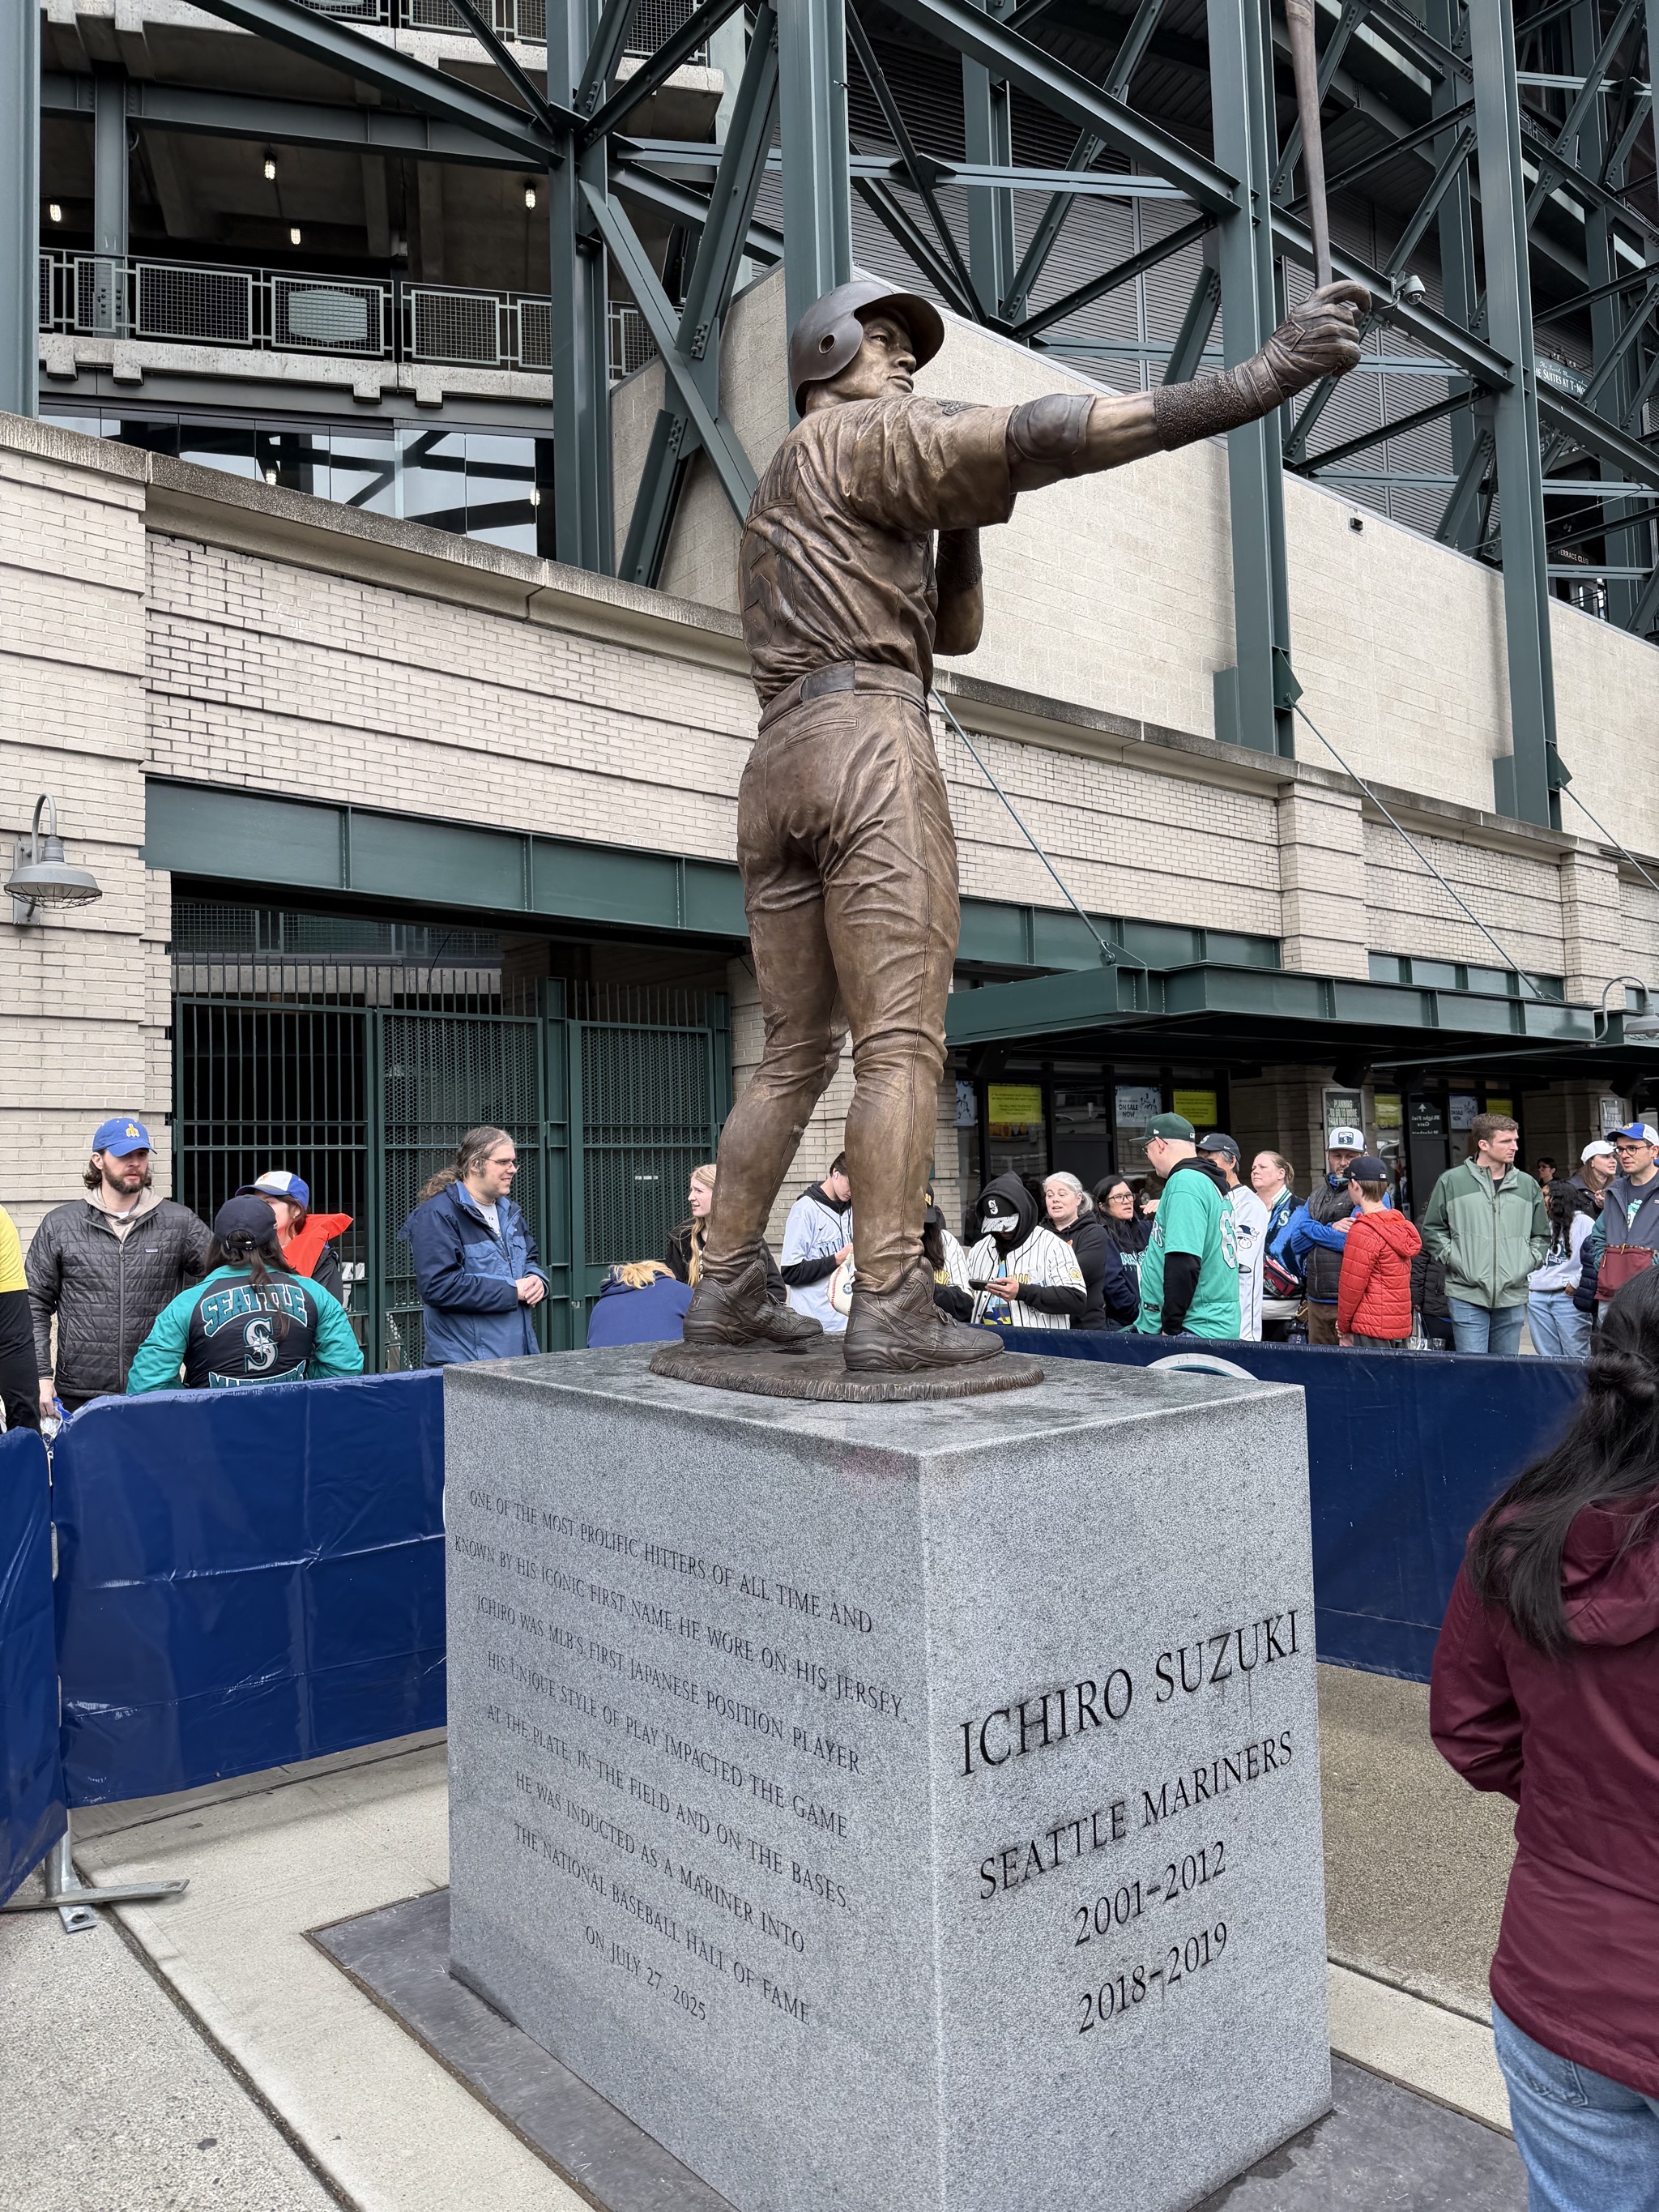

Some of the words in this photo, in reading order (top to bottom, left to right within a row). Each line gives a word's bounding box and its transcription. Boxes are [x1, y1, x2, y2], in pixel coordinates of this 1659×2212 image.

[1543, 369, 1562, 385] SUITES
[1563, 378, 1569, 388] AT
[987, 1199, 999, 1215] S
[1278, 1210, 1290, 1227] S
[200, 1283, 308, 1337] SEATTLE
[244, 1317, 279, 1373] S
[454, 1535, 495, 1564] KNOWN
[500, 1551, 512, 1570] BY
[517, 1558, 536, 1580] HIS
[542, 1566, 585, 1598] ICONIC
[591, 1584, 625, 1613] FIRST
[630, 1599, 673, 1632] NAME
[680, 1616, 700, 1641] HE
[707, 1626, 753, 1662] WORE
[761, 1647, 787, 1674] ON
[794, 1659, 827, 1690] HIS
[835, 1673, 908, 1723] JERSEY,
[470, 1489, 492, 1511] ONE
[496, 1497, 510, 1516] OF
[514, 1503, 537, 1526] THE
[543, 1511, 575, 1537] MOST
[580, 1523, 638, 1557] PROLIFIC
[644, 1543, 706, 1580] HITTERS
[713, 1565, 733, 1587] OF
[740, 1574, 770, 1601] ALL
[776, 1583, 821, 1617] TIME
[830, 1602, 872, 1633] AND
[476, 1595, 515, 1625] ICHIRO
[519, 1612, 544, 1638] WAS
[548, 1624, 583, 1655] MLB'S
[590, 1642, 625, 1672] FIRST
[629, 1658, 699, 1705] JAPANESE
[707, 1690, 783, 1740] POSITION
[960, 1668, 1134, 1778] ICHIRO
[1155, 1609, 1301, 1704] SUZUKI
[488, 1650, 506, 1674] HIS
[510, 1660, 556, 1699] UNIQUE
[561, 1685, 597, 1719] STYLE
[603, 1706, 621, 1728] OF
[625, 1715, 658, 1748] PLAY
[664, 1734, 742, 1787] IMPACTED
[749, 1774, 784, 1808] THE
[792, 1795, 847, 1839] GAME
[488, 1705, 501, 1723] AT
[505, 1712, 528, 1739] THE
[533, 1725, 572, 1762] PLATE,
[578, 1749, 591, 1771] IN
[596, 1760, 624, 1790] THE
[629, 1777, 670, 1814] FIELD
[676, 1803, 710, 1834] AND
[717, 1823, 742, 1852] ON
[748, 1838, 783, 1875] THE
[791, 1861, 852, 1911] BASES.
[979, 1801, 1128, 1901] SEATTLE
[1141, 1729, 1293, 1830] MARINERS
[514, 1822, 538, 1853] THE
[543, 1840, 608, 1898] NATIONAL
[612, 1883, 680, 1944] BASEBALL
[686, 1930, 727, 1974] HALL
[734, 1961, 756, 1988] OF
[762, 1977, 810, 2026] FAME
[516, 1771, 532, 1795] HE
[536, 1783, 562, 1812] WAS
[566, 1799, 635, 1855] INDUCTED
[641, 1843, 658, 1868] AS
[664, 1857, 674, 1878] A
[680, 1865, 753, 1926] MARINER
[761, 1911, 805, 1953] INTO
[585, 1925, 605, 1953] ON
[609, 1941, 641, 1977] JULY
